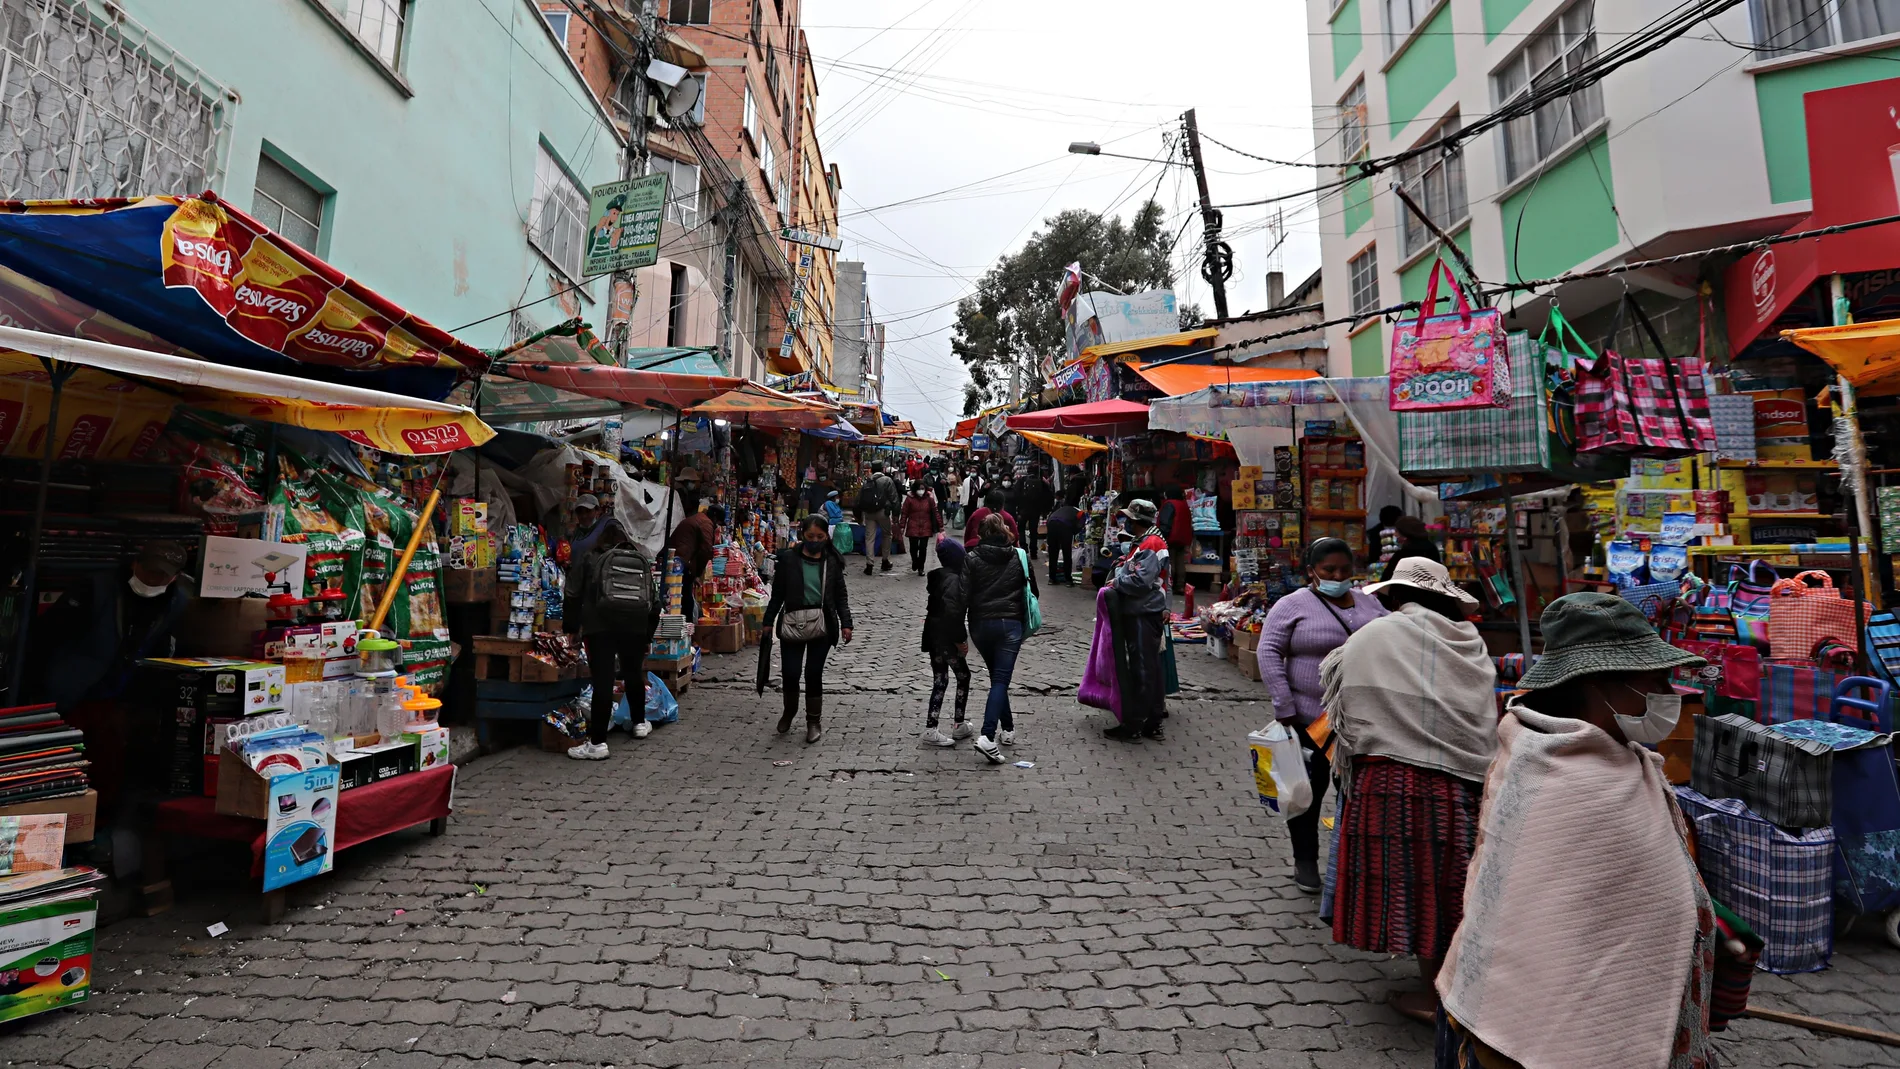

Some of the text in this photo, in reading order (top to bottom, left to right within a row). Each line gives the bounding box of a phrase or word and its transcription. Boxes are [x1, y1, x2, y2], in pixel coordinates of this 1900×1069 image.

[235, 285, 306, 322] Sabrosa
[305, 328, 374, 359] Sabrosa
[1414, 378, 1470, 397] POOH
[1757, 409, 1801, 419] indsor
[1754, 527, 1818, 539] HELLMANN'S
